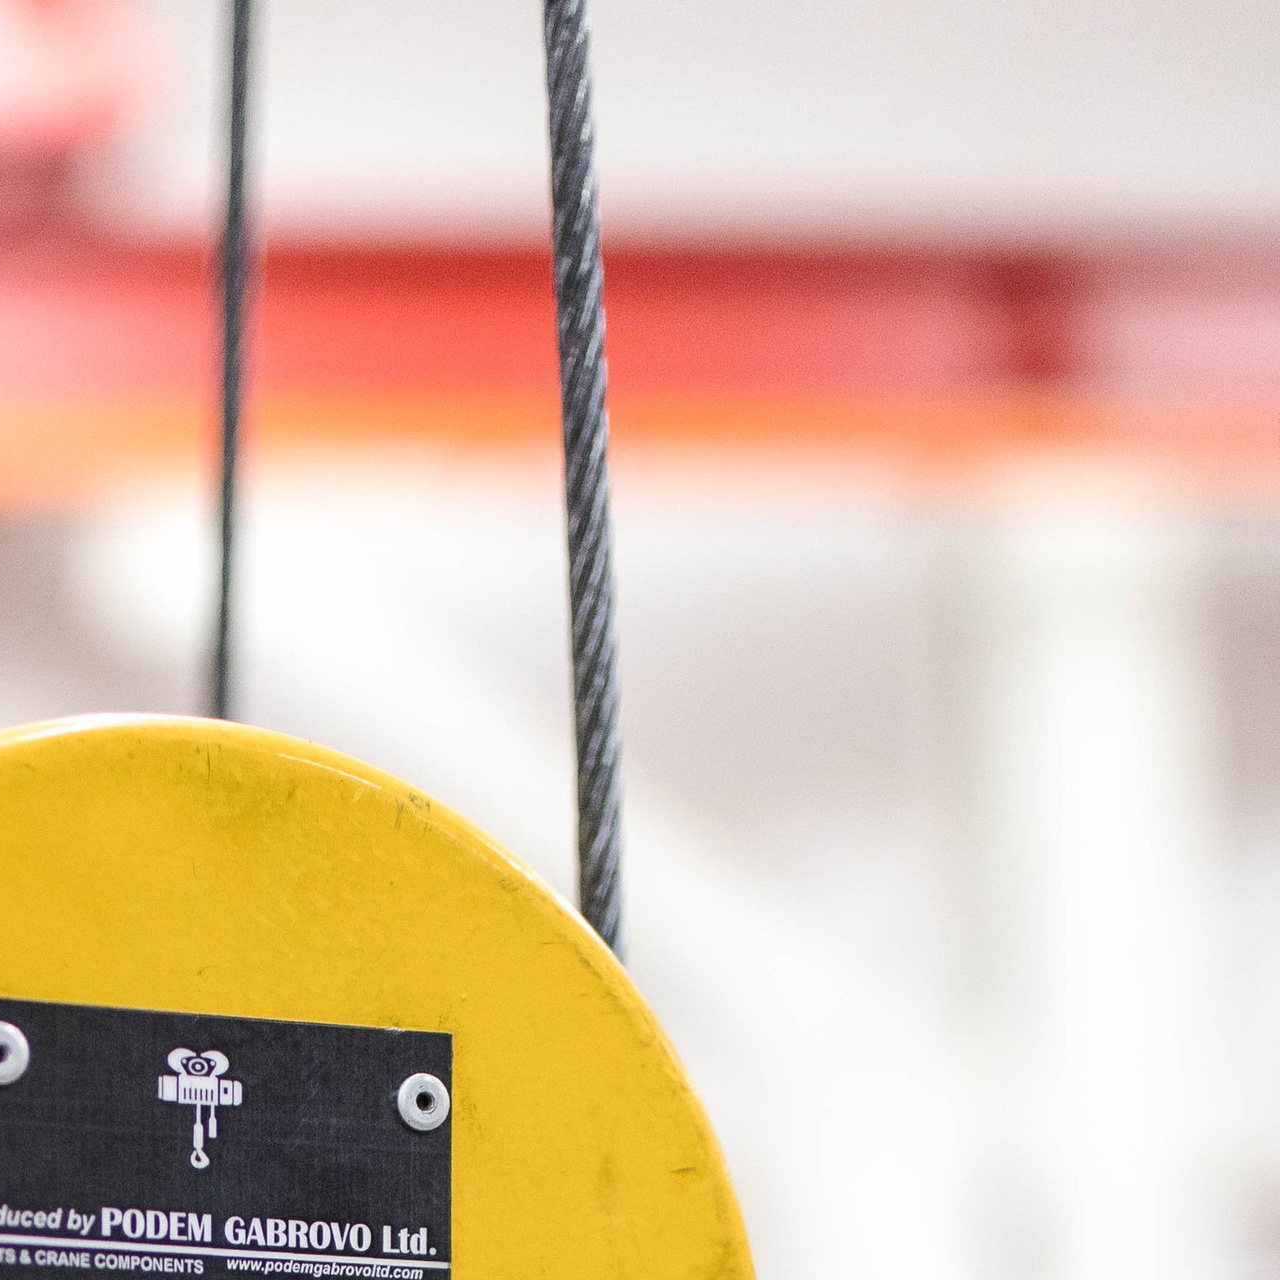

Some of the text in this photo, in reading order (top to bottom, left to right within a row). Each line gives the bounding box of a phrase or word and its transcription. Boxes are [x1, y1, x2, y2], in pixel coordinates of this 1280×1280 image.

[67, 1209, 95, 1235] by
[101, 1207, 212, 1242] PODEM
[224, 1216, 372, 1252] GABROVO
[383, 1226, 437, 1256] Ltd.
[19, 1249, 32, 1264] &
[35, 1250, 91, 1269] CRANE
[94, 1252, 204, 1274] COMPONENTS
[226, 1258, 424, 1280] www.podemgabrovoltd.com
